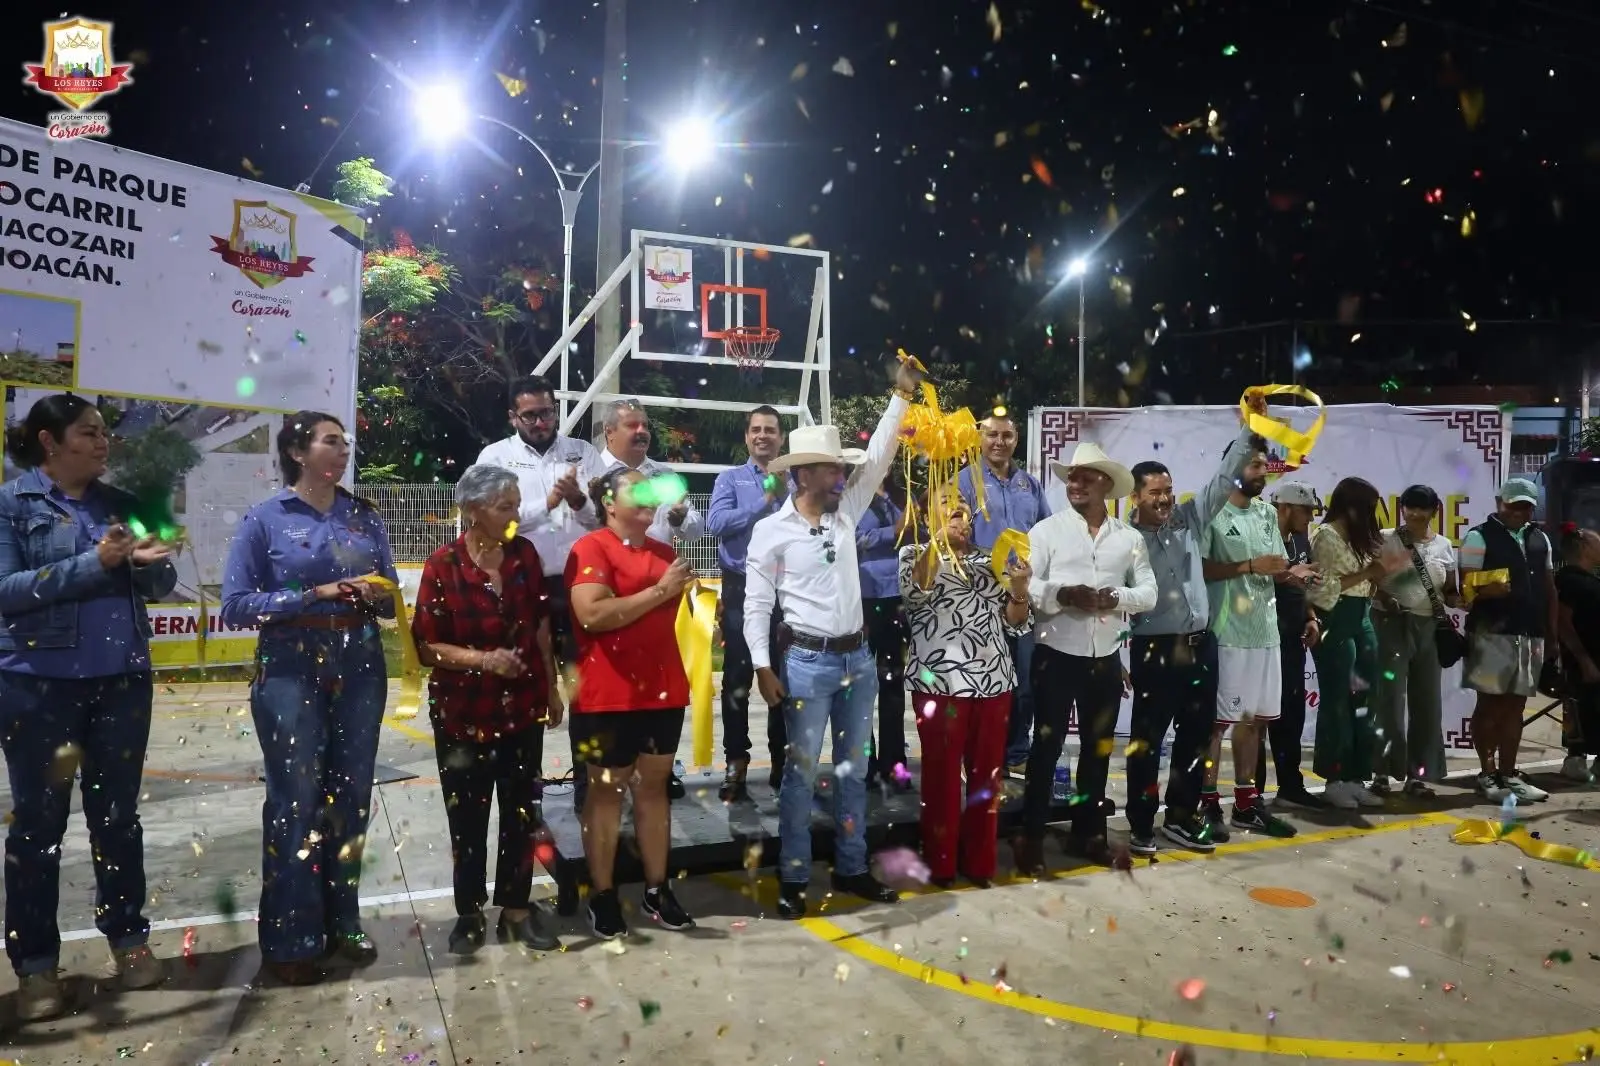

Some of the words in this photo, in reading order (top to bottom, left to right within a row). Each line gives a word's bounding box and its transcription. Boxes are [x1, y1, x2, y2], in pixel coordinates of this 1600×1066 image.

[0, 143, 39, 174] DE
[53, 157, 187, 208] PARQUE
[0, 216, 135, 260] ACOZARI
[0, 246, 121, 286] OACÁN.
[239, 255, 257, 265] LOS
[260, 259, 289, 272] REYES
[231, 299, 292, 318] Corazón
